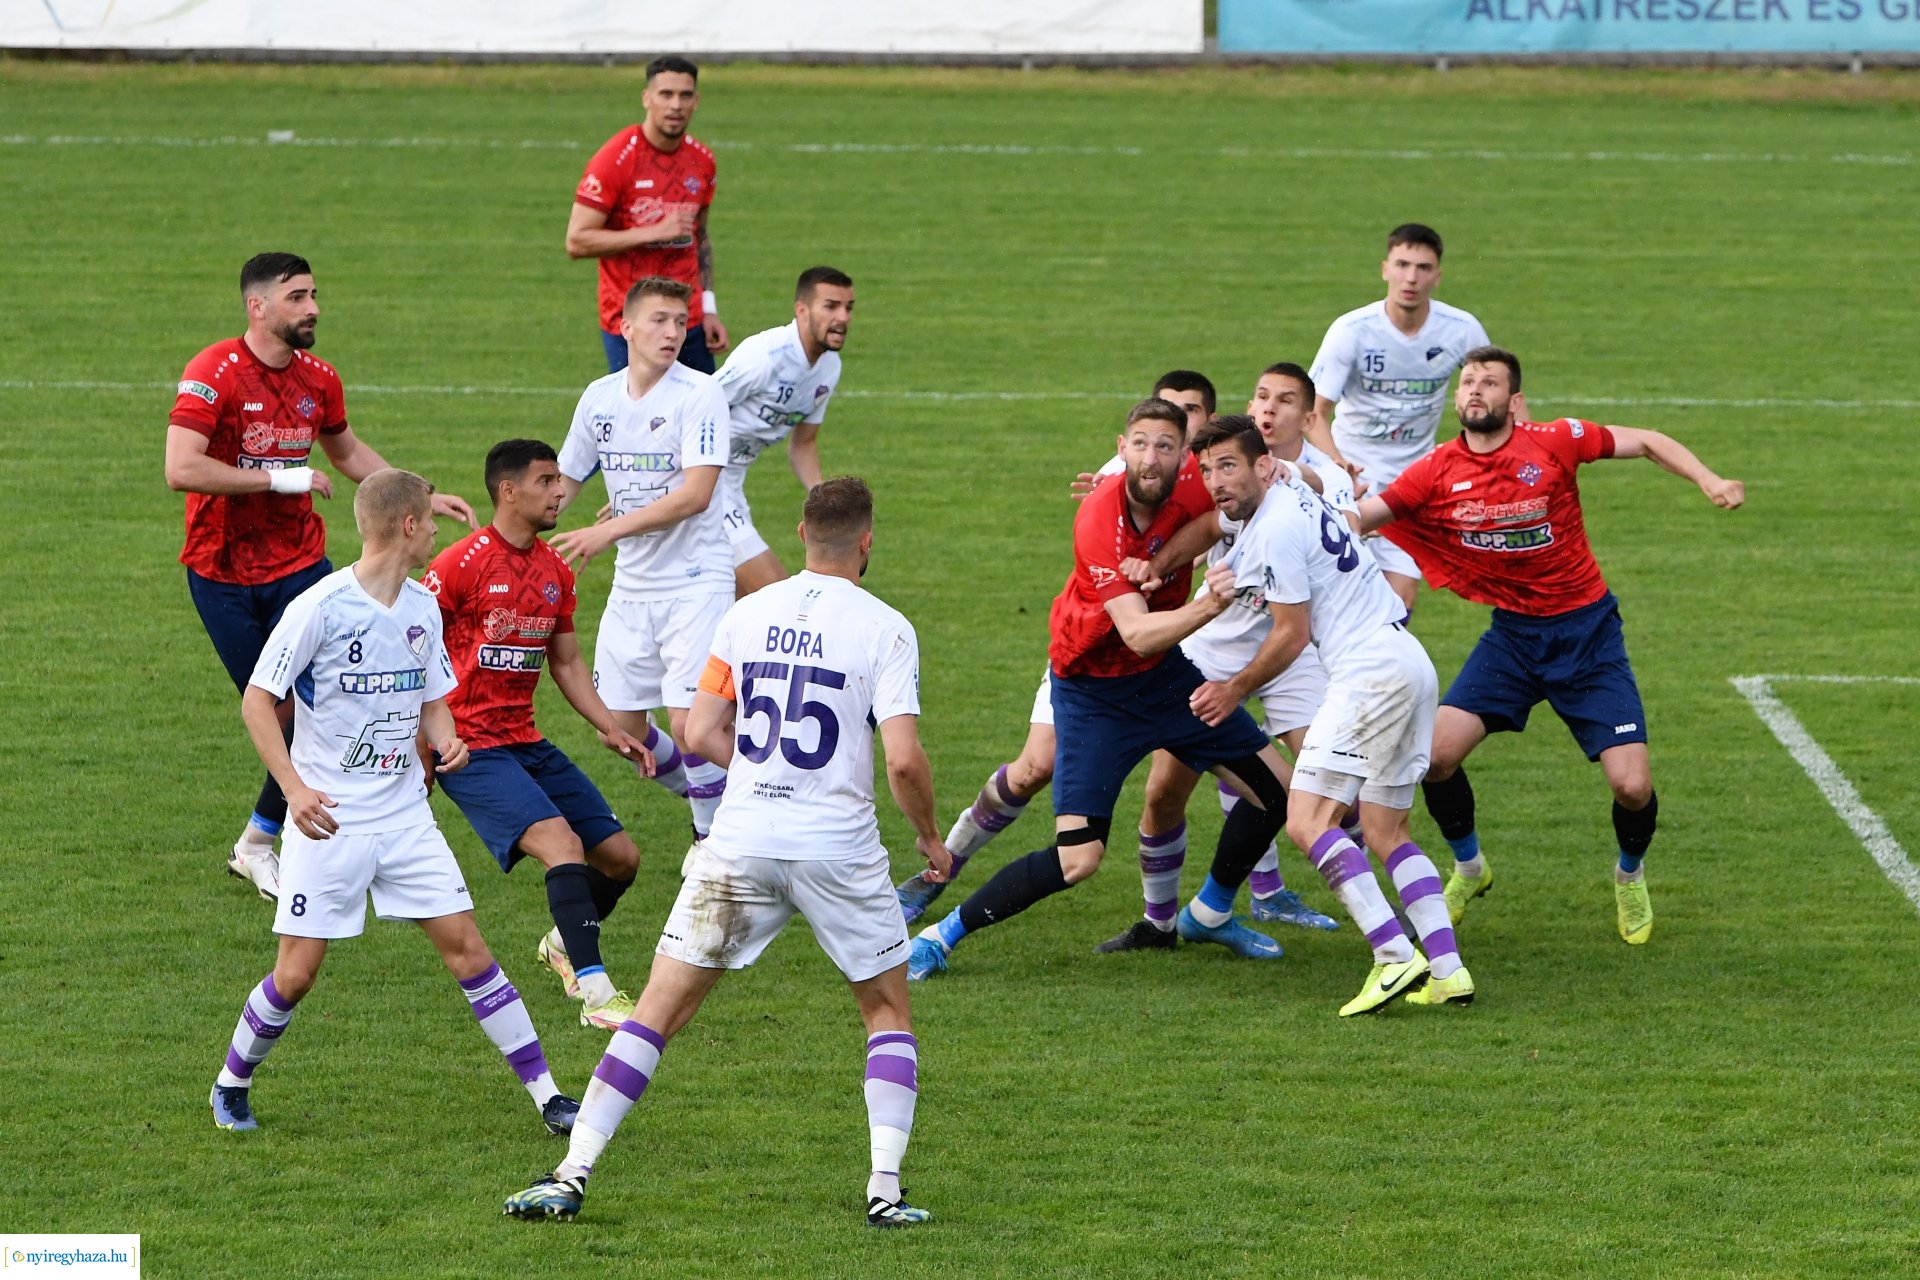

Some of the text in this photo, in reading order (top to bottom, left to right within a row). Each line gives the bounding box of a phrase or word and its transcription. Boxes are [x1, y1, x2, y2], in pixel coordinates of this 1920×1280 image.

[1880, 0, 1920, 21] G
[1364, 354, 1385, 373] 15
[777, 386, 794, 405] 19
[243, 402, 263, 411] JAKO
[595, 422, 613, 443] 28
[489, 584, 509, 593] JAKO
[349, 640, 363, 664] 8
[766, 626, 823, 659] BORA
[738, 661, 846, 770] 55
[343, 743, 411, 769] Drén
[290, 893, 307, 917] 8
